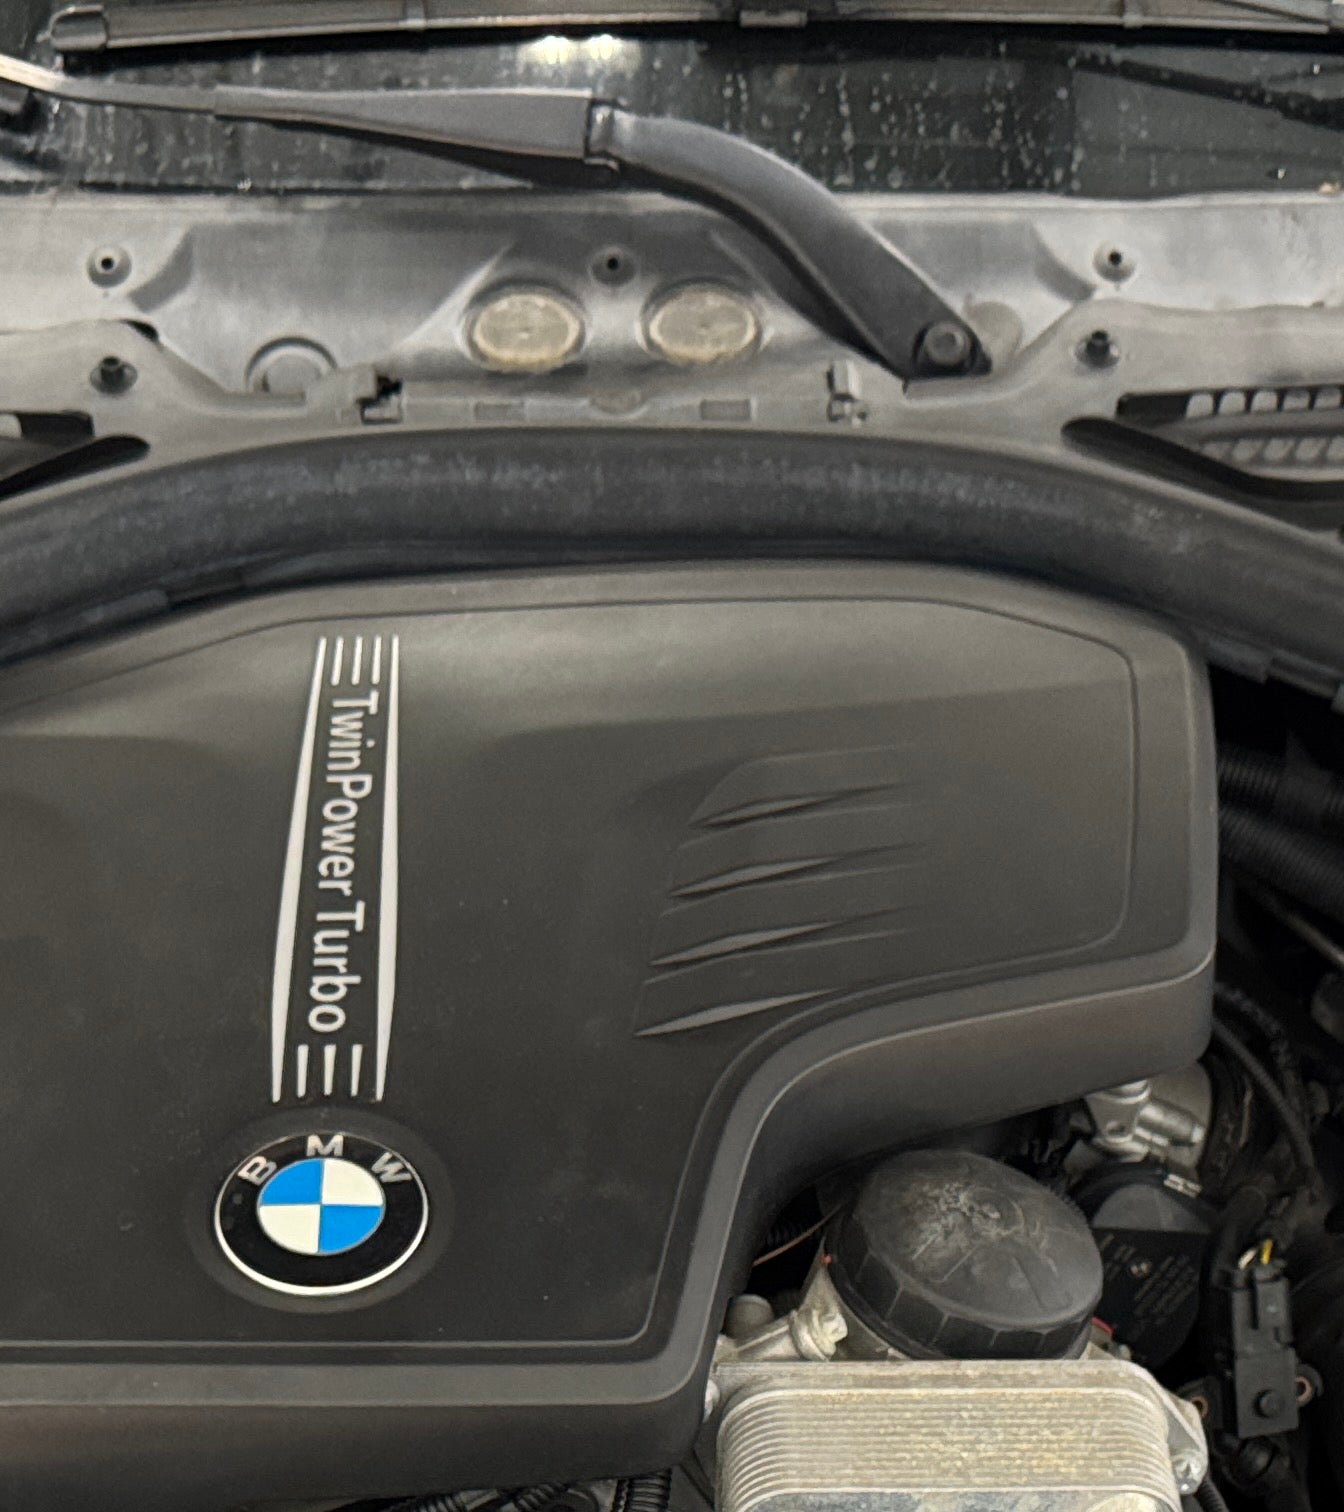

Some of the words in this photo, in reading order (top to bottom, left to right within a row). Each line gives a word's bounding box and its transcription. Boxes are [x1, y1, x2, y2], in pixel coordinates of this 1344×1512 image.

[317, 689, 380, 897] TwinPower
[307, 900, 366, 1034] Turbo
[237, 1133, 413, 1187] BMW
